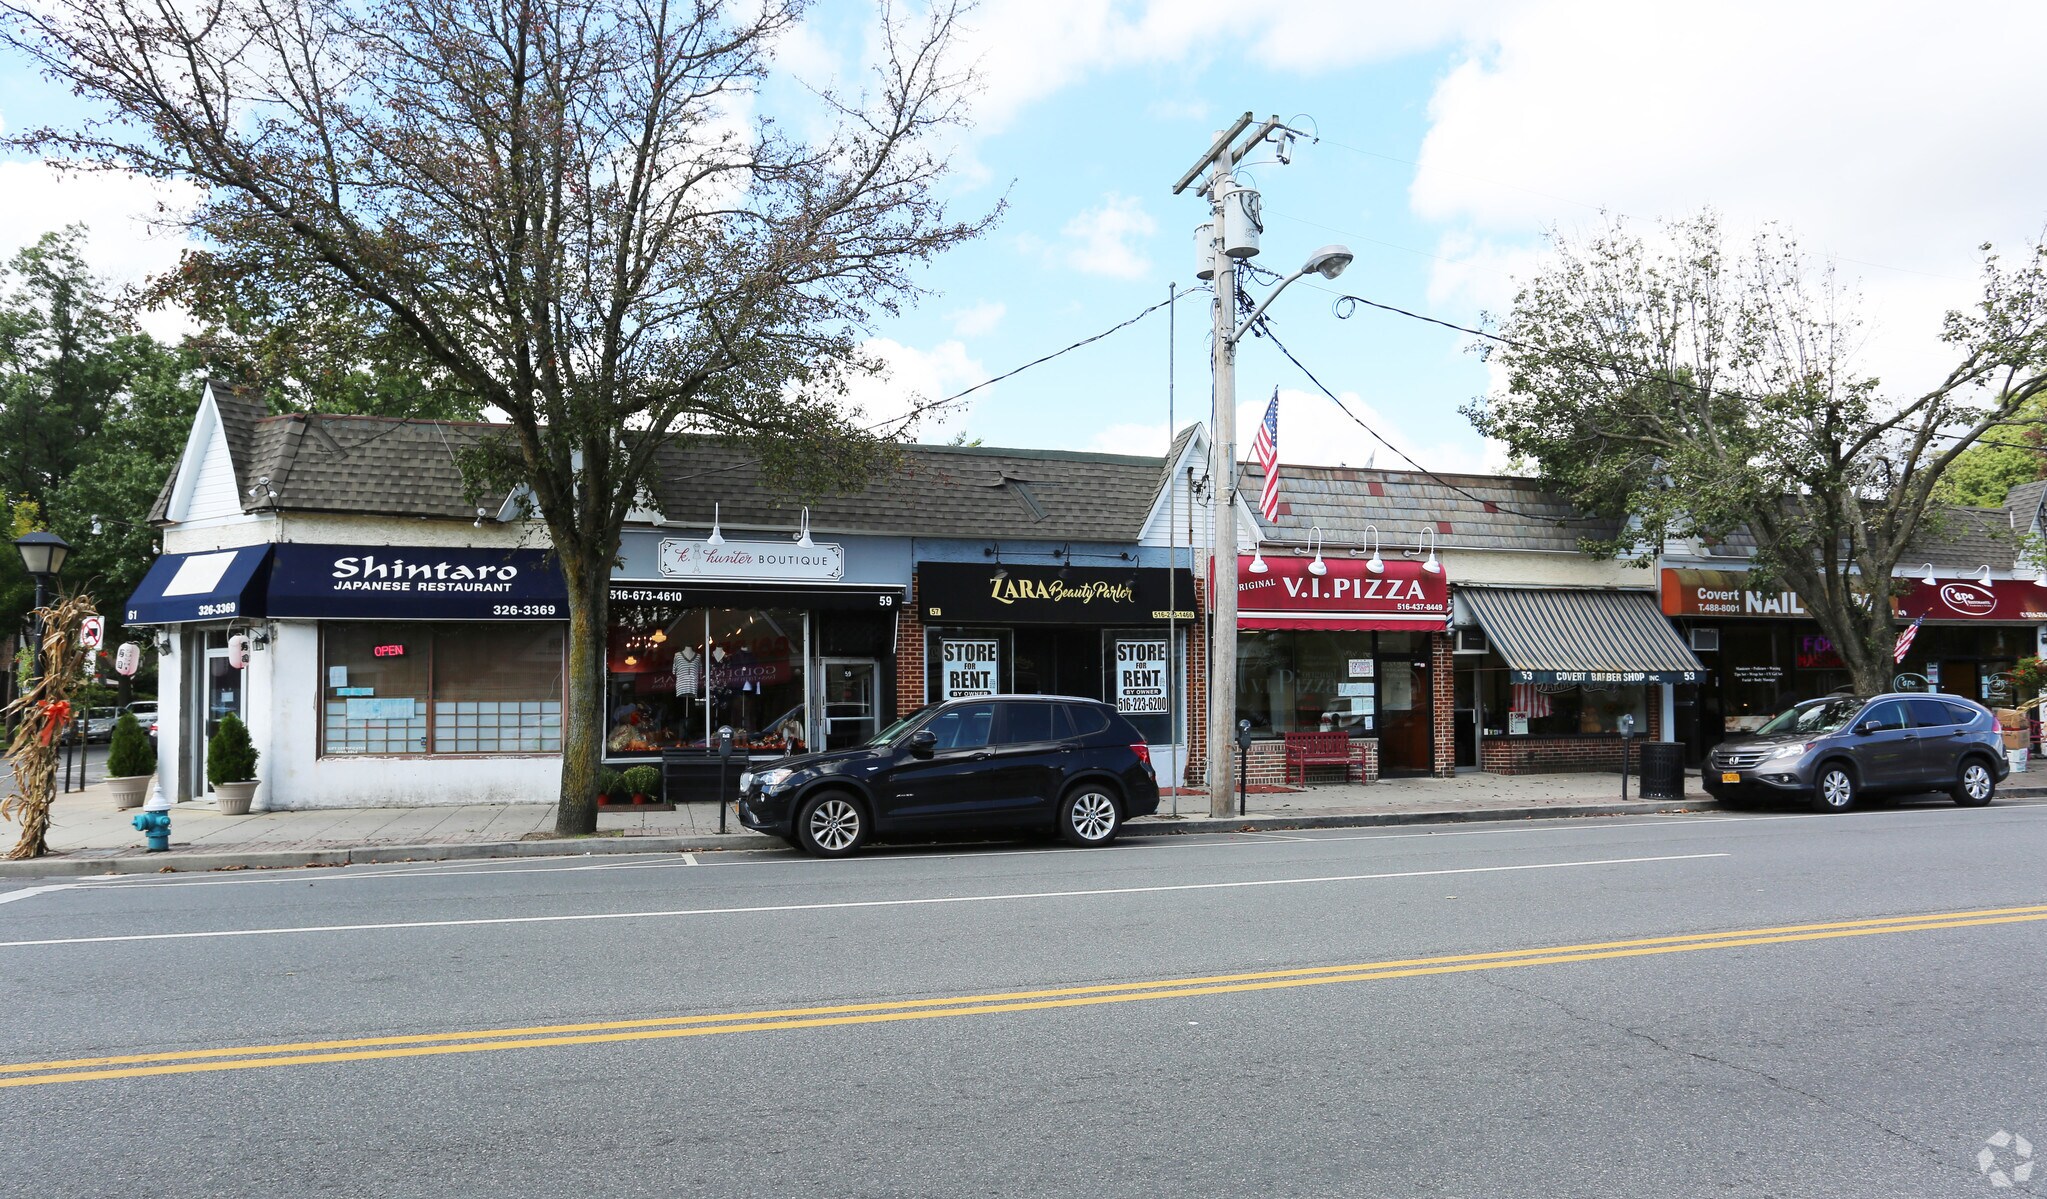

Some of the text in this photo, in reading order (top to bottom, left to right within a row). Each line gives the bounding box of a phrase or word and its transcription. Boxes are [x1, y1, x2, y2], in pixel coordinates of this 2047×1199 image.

[703, 549, 753, 564] hunter
[758, 555, 828, 566] BOUTIQUE
[332, 555, 518, 580] Shintaro
[333, 581, 512, 592] JAPANESE RESTAURANT
[1237, 578, 1276, 591] RIGINAL
[610, 590, 682, 602] 516-673-4610
[990, 579, 1135, 604] ZARA Beauty Parlor
[1697, 587, 1740, 600] Covert
[1945, 587, 1974, 606] Capo
[879, 596, 893, 607] 59
[1397, 603, 1443, 611] 516-437-8449
[1698, 603, 1740, 612] T.488-8001
[128, 610, 138, 620] 61
[198, 602, 236, 616] 326-3369
[493, 604, 556, 615] 326-3369
[374, 645, 404, 657] OPEN
[944, 643, 996, 662] STORE
[1117, 643, 1165, 661] STORE
[964, 662, 976, 670] FOR
[950, 671, 991, 688] RENT
[1123, 670, 1160, 687] RENT
[1521, 671, 1533, 680] 53
[1556, 672, 1586, 682] COVERT
[1623, 672, 1645, 682] SHOP
[1684, 672, 1695, 681] 53
[1118, 697, 1167, 711] 516-223-6200
